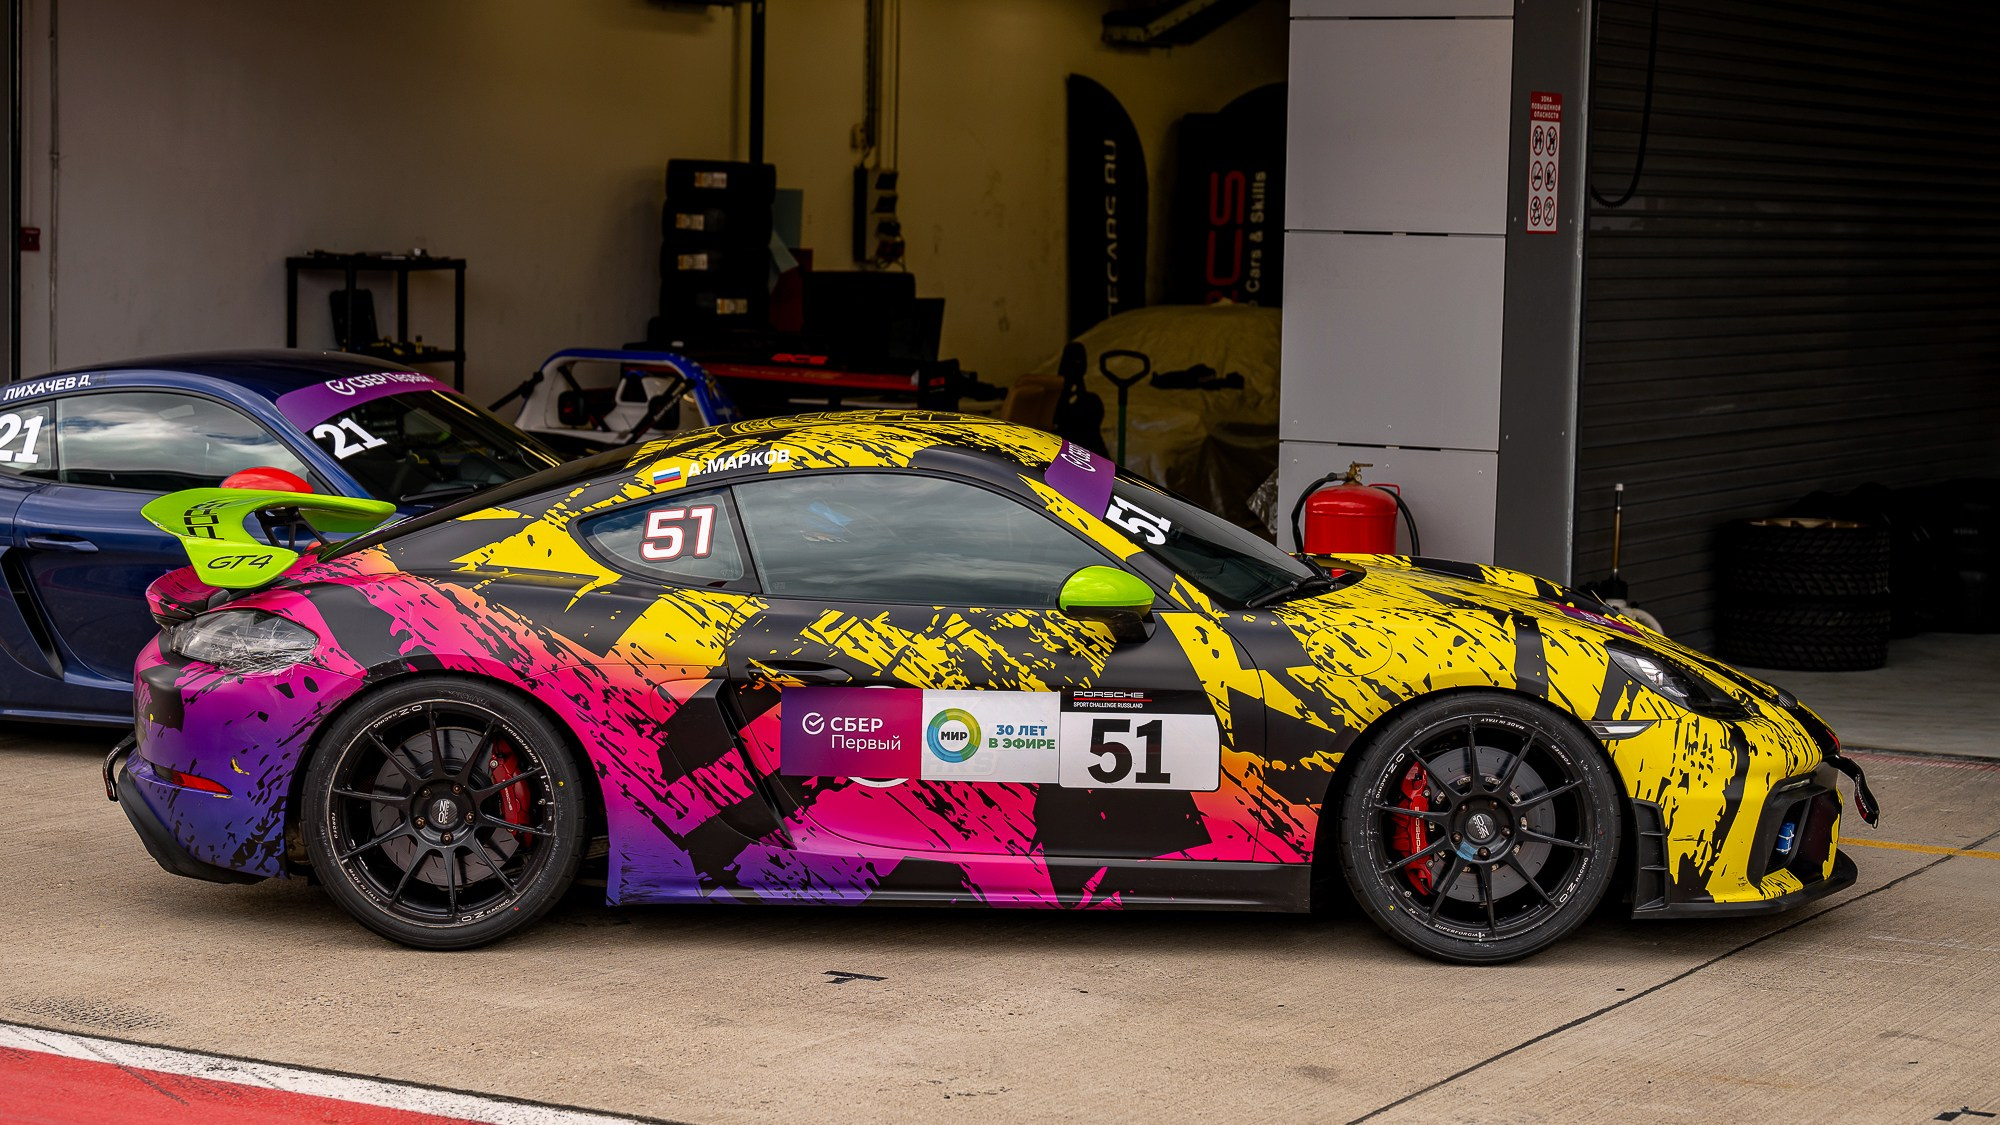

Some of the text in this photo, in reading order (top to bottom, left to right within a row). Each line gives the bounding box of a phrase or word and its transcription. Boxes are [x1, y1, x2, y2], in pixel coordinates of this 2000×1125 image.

[1534, 111, 1559, 119] ОПАСНОСТИ
[1249, 170, 1267, 224] Skills
[1248, 229, 1264, 243] &
[1245, 248, 1263, 294] Cars
[3, 374, 91, 401] ЛИХАЧЕВ Д.
[347, 373, 387, 388] СБЕР
[0, 413, 44, 464] 21
[312, 417, 388, 460] 21
[1105, 495, 1172, 545] 51
[641, 506, 716, 560] 51
[207, 554, 274, 570] GT4
[830, 717, 884, 733] СБЕР
[996, 724, 1048, 736] 30 ЛЕТ
[831, 734, 901, 752] Первый
[940, 731, 968, 741] МИР
[988, 737, 1056, 749] В ЭФИРЕ
[1087, 718, 1171, 784] 51
[1575, 857, 1589, 882] RACING
[486, 899, 511, 915] RACING
[1434, 924, 1486, 937] SUPERFORGIAA
